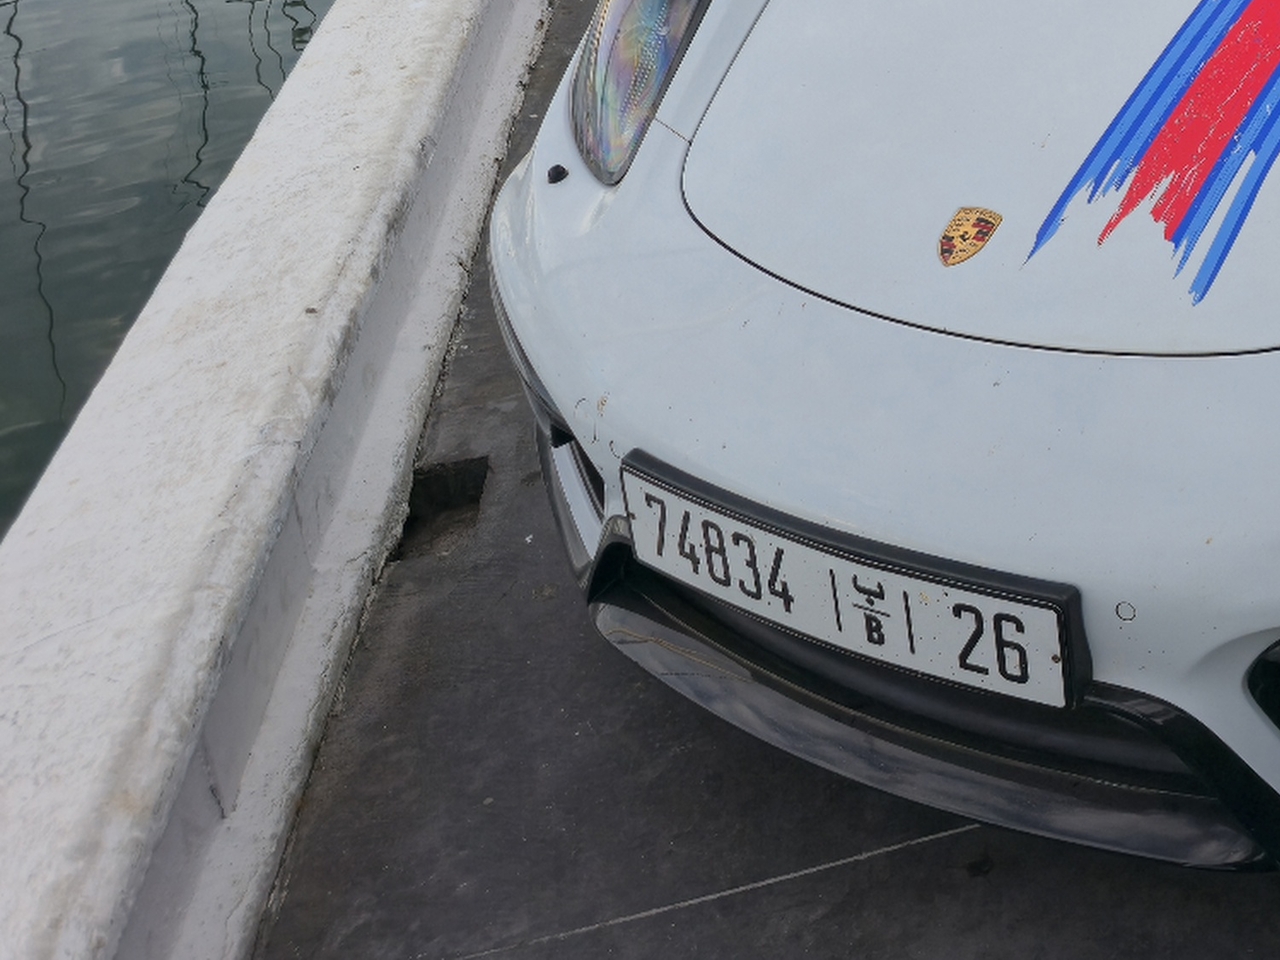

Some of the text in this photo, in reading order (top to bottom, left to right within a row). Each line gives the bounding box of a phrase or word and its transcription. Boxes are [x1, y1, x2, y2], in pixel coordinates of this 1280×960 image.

[645, 491, 1030, 685] 74834 B 26
